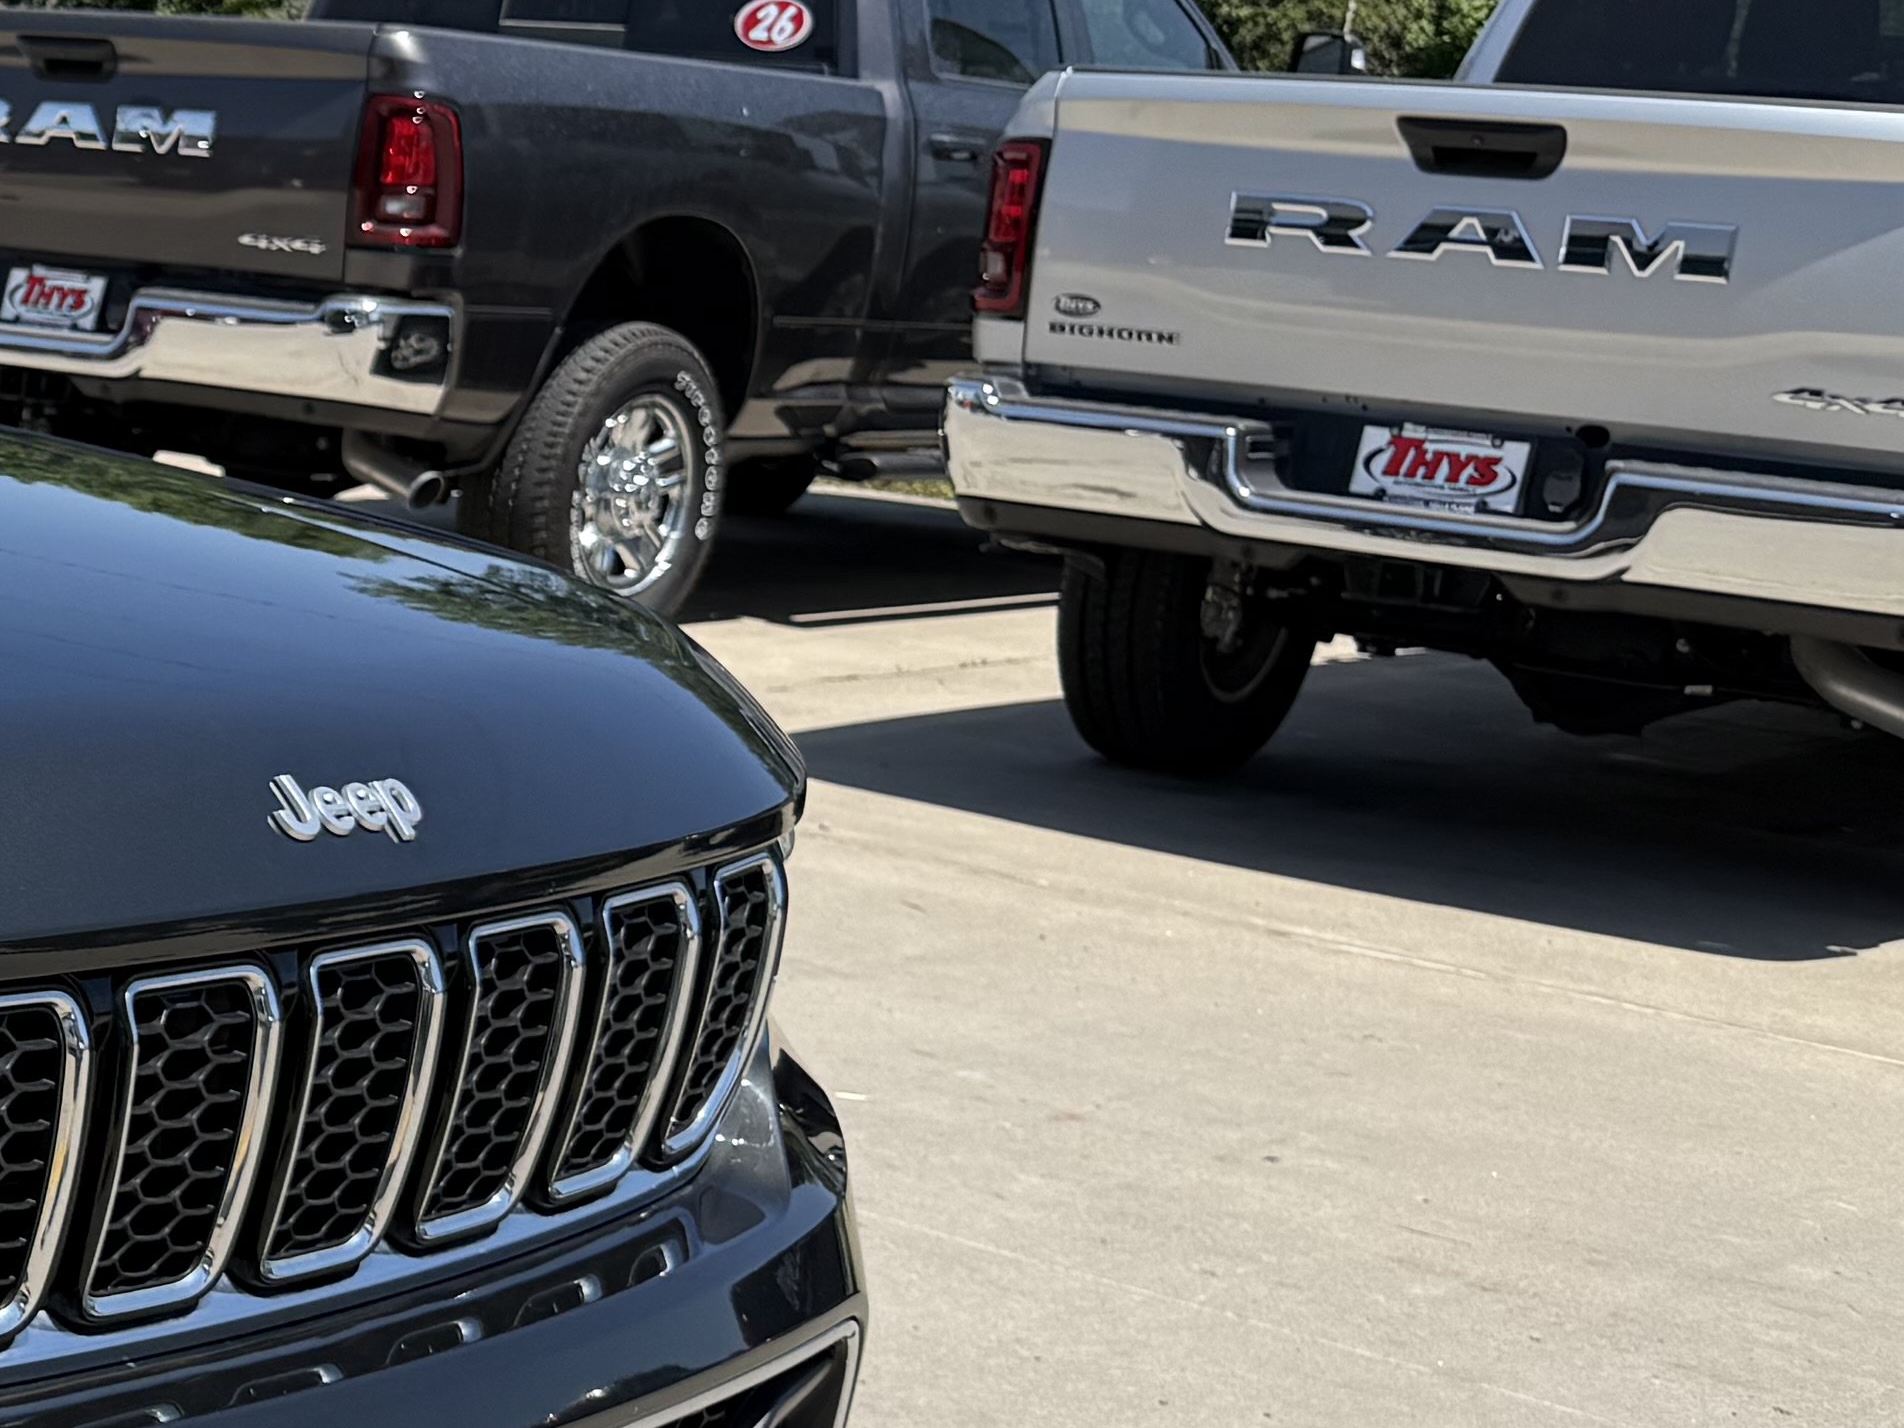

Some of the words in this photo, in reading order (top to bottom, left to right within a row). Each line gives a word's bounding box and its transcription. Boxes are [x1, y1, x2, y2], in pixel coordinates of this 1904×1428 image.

[749, 3, 798, 44] 26
[1223, 190, 1740, 285] RAM
[19, 274, 90, 312] THYS
[1048, 321, 1178, 346] BIGHORN
[1382, 435, 1504, 487] THYS
[267, 773, 423, 843] Jeep
